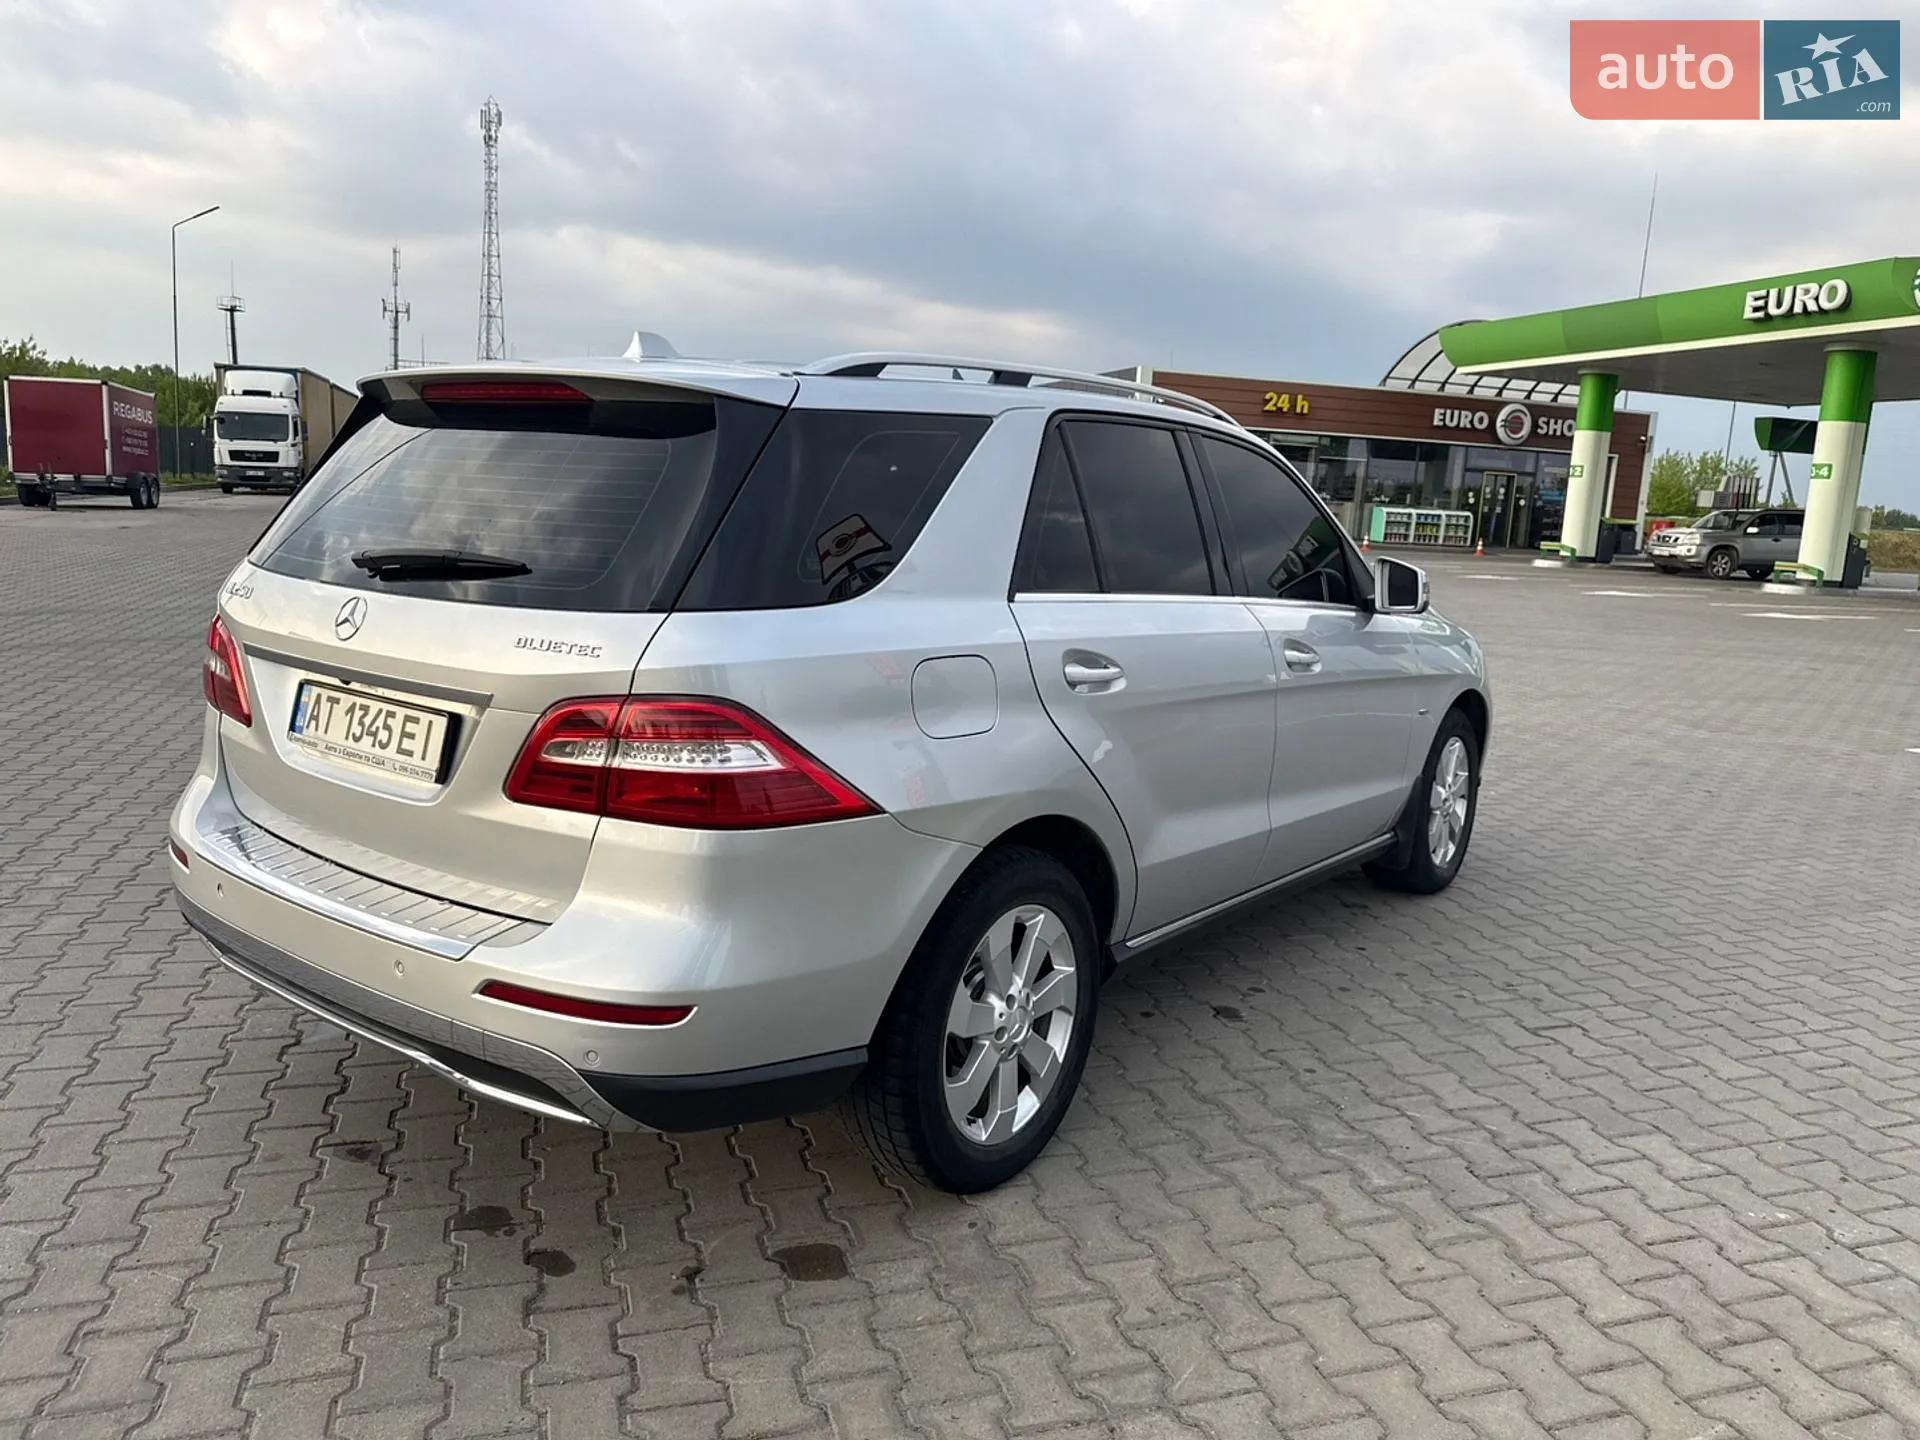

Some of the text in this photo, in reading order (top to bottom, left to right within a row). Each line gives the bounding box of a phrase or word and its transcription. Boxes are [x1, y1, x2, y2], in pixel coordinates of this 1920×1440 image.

[1743, 278, 1850, 320] EURO
[112, 400, 153, 424] REGABUS
[1263, 391, 1309, 414] 24 h
[1432, 407, 1489, 430] EURO
[513, 634, 603, 659] BLUETEC
[305, 692, 341, 735] AT
[344, 701, 397, 750] 1345
